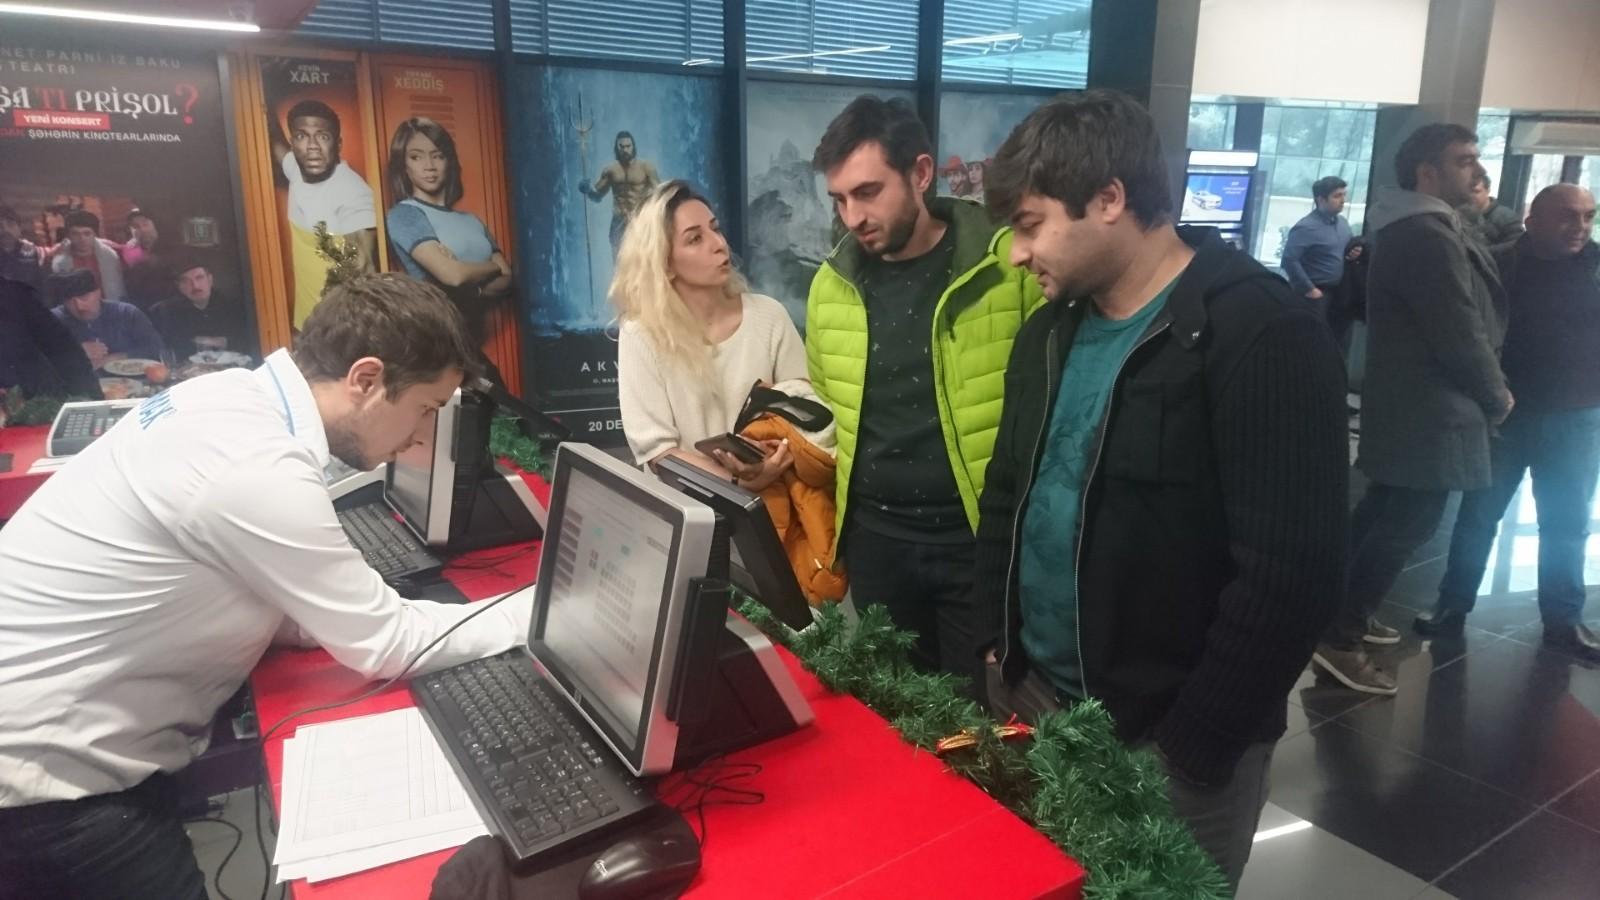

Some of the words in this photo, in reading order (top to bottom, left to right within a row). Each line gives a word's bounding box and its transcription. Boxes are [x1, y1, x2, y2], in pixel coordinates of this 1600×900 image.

[289, 70, 330, 85] XART
[51, 115, 102, 127] KONSERT
[588, 421, 603, 432] 20
